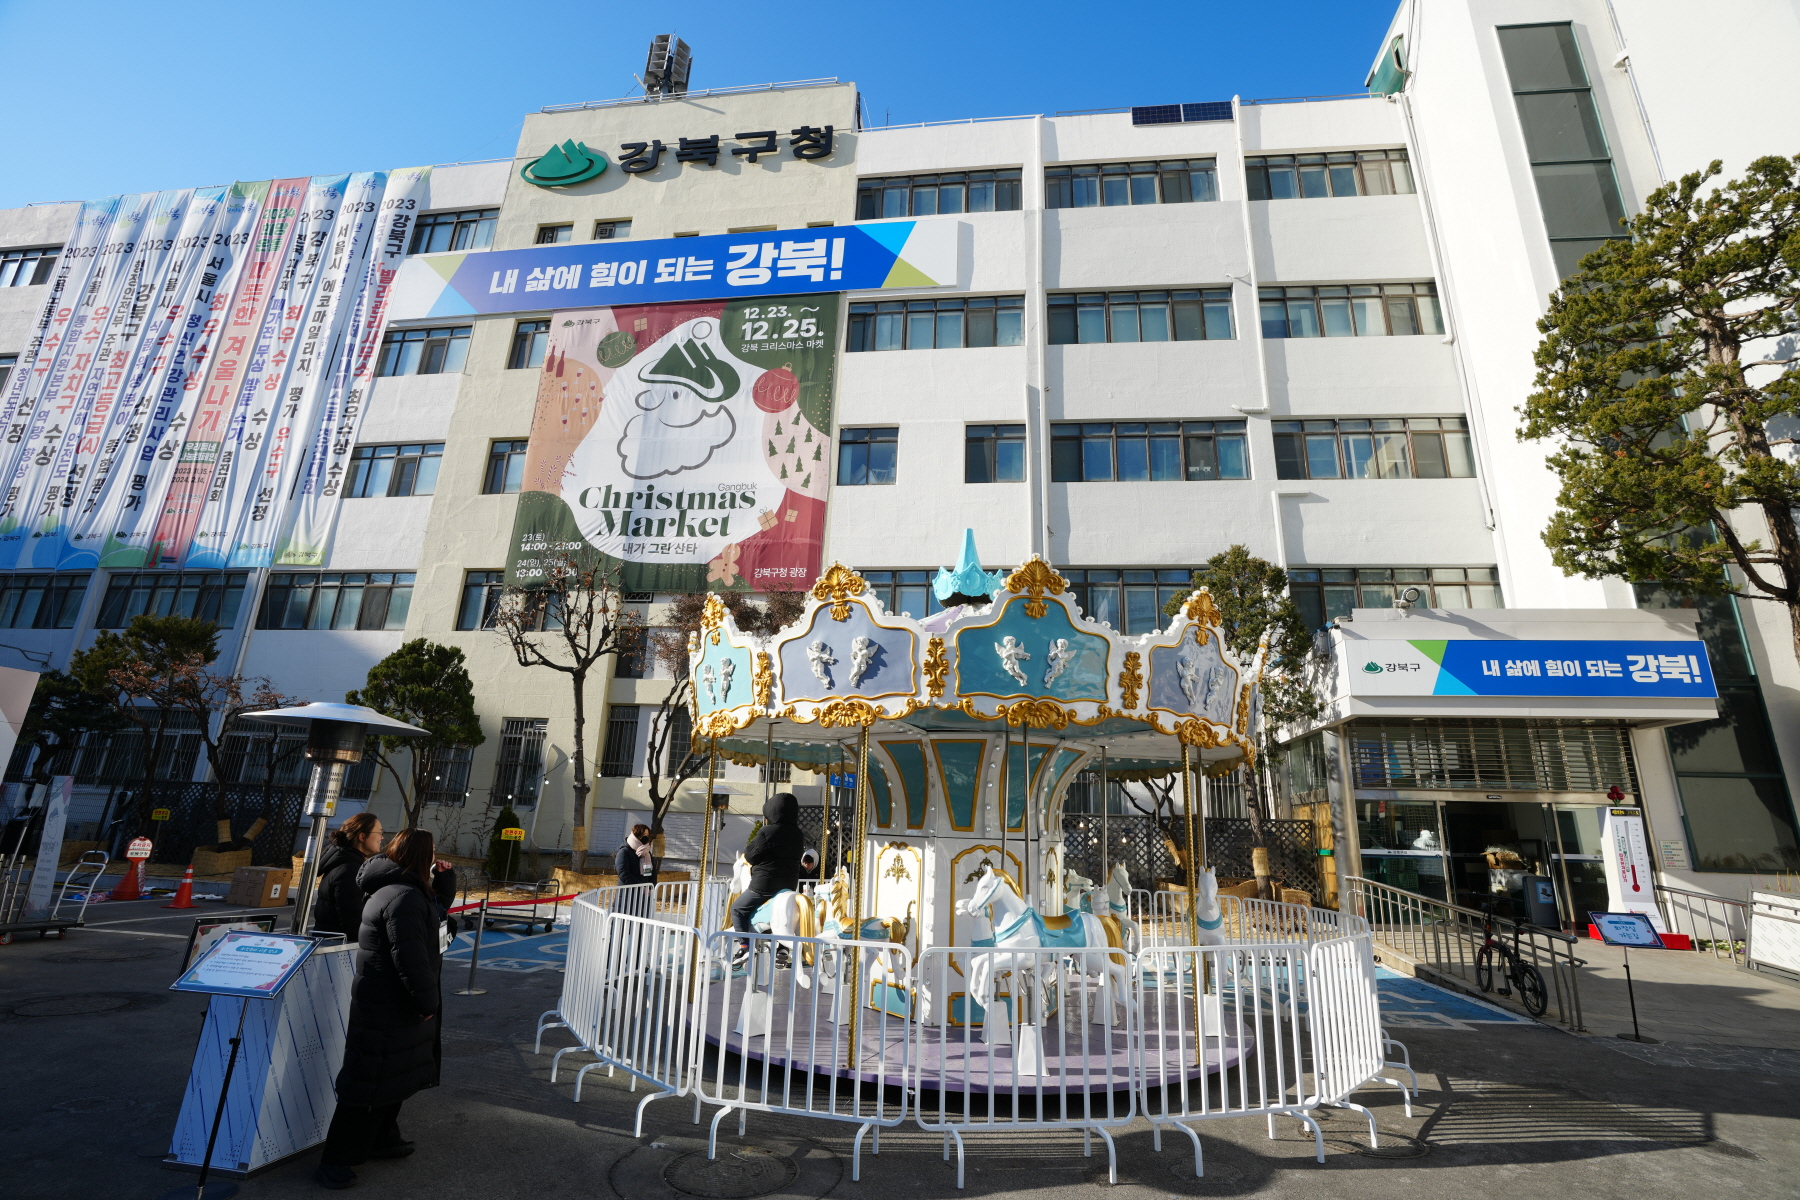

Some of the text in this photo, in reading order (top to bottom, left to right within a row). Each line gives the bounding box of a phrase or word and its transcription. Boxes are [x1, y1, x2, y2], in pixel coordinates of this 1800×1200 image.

[618, 125, 834, 174] 강북구청
[263, 208, 296, 220] 2024
[341, 202, 376, 216] 2023
[381, 199, 416, 211] 2023
[214, 233, 249, 246] 2023
[255, 238, 283, 252] 온돌
[260, 222, 289, 236] 희망
[384, 214, 411, 258] 강북구
[65, 246, 97, 259] 2023
[329, 223, 349, 270] 서울시
[194, 256, 225, 304] 서울시
[489, 237, 846, 294] 내 삶에 힘이 되는 강북!
[158, 260, 183, 309] 서울시
[297, 277, 337, 377] 「에코마일리지」
[353, 262, 397, 383] 「빌라관리사무소」
[741, 318, 824, 341] 12.25.
[743, 306, 792, 319] 12.23.
[24, 336, 43, 363] 주관
[129, 320, 163, 389] 식품위생
[197, 261, 272, 432] 따뜻한 겨울나기
[244, 231, 327, 451] 강북구 최우수상 수상
[741, 339, 824, 352] 강북 크리스마스 마켓
[7, 307, 72, 443] 우수구 선정
[124, 304, 184, 443] 우수구 선정
[250, 344, 270, 373] 무상
[0, 266, 106, 517] 서울시 통합지원본부 역량 향상 평가
[35, 306, 110, 466] 우수 자치구 수상
[40, 259, 145, 516] 행정안전부 주관 자연재해 안전도 평가
[140, 314, 203, 462] 정신건강관리사업
[158, 292, 229, 461] 최우수상 수상
[239, 378, 260, 406] 방문
[60, 283, 156, 508] 강북구 최고등급(A) 선정
[115, 392, 137, 426] 분야
[283, 386, 303, 419] 평가
[332, 388, 364, 456] 최우수상
[184, 442, 218, 452] 우리동네
[266, 427, 291, 479] 우수구
[124, 474, 147, 512] 평가
[208, 451, 233, 502] 경진대회
[323, 462, 344, 497] 수상
[717, 482, 758, 492] Gangbuk
[252, 487, 274, 522] 선정
[578, 484, 757, 511] Christmas
[522, 533, 545, 541] 23(토)
[596, 508, 734, 538] Market
[521, 542, 547, 551] 14:00
[554, 541, 582, 550] 21:00
[622, 542, 699, 555] 내가 그린 산타
[516, 568, 543, 577] 13:00
[754, 567, 807, 578] 강북구청 광장
[1385, 662, 1421, 673] 강북구
[1482, 654, 1703, 684] 내 삶에 힘이 되는 강북!
